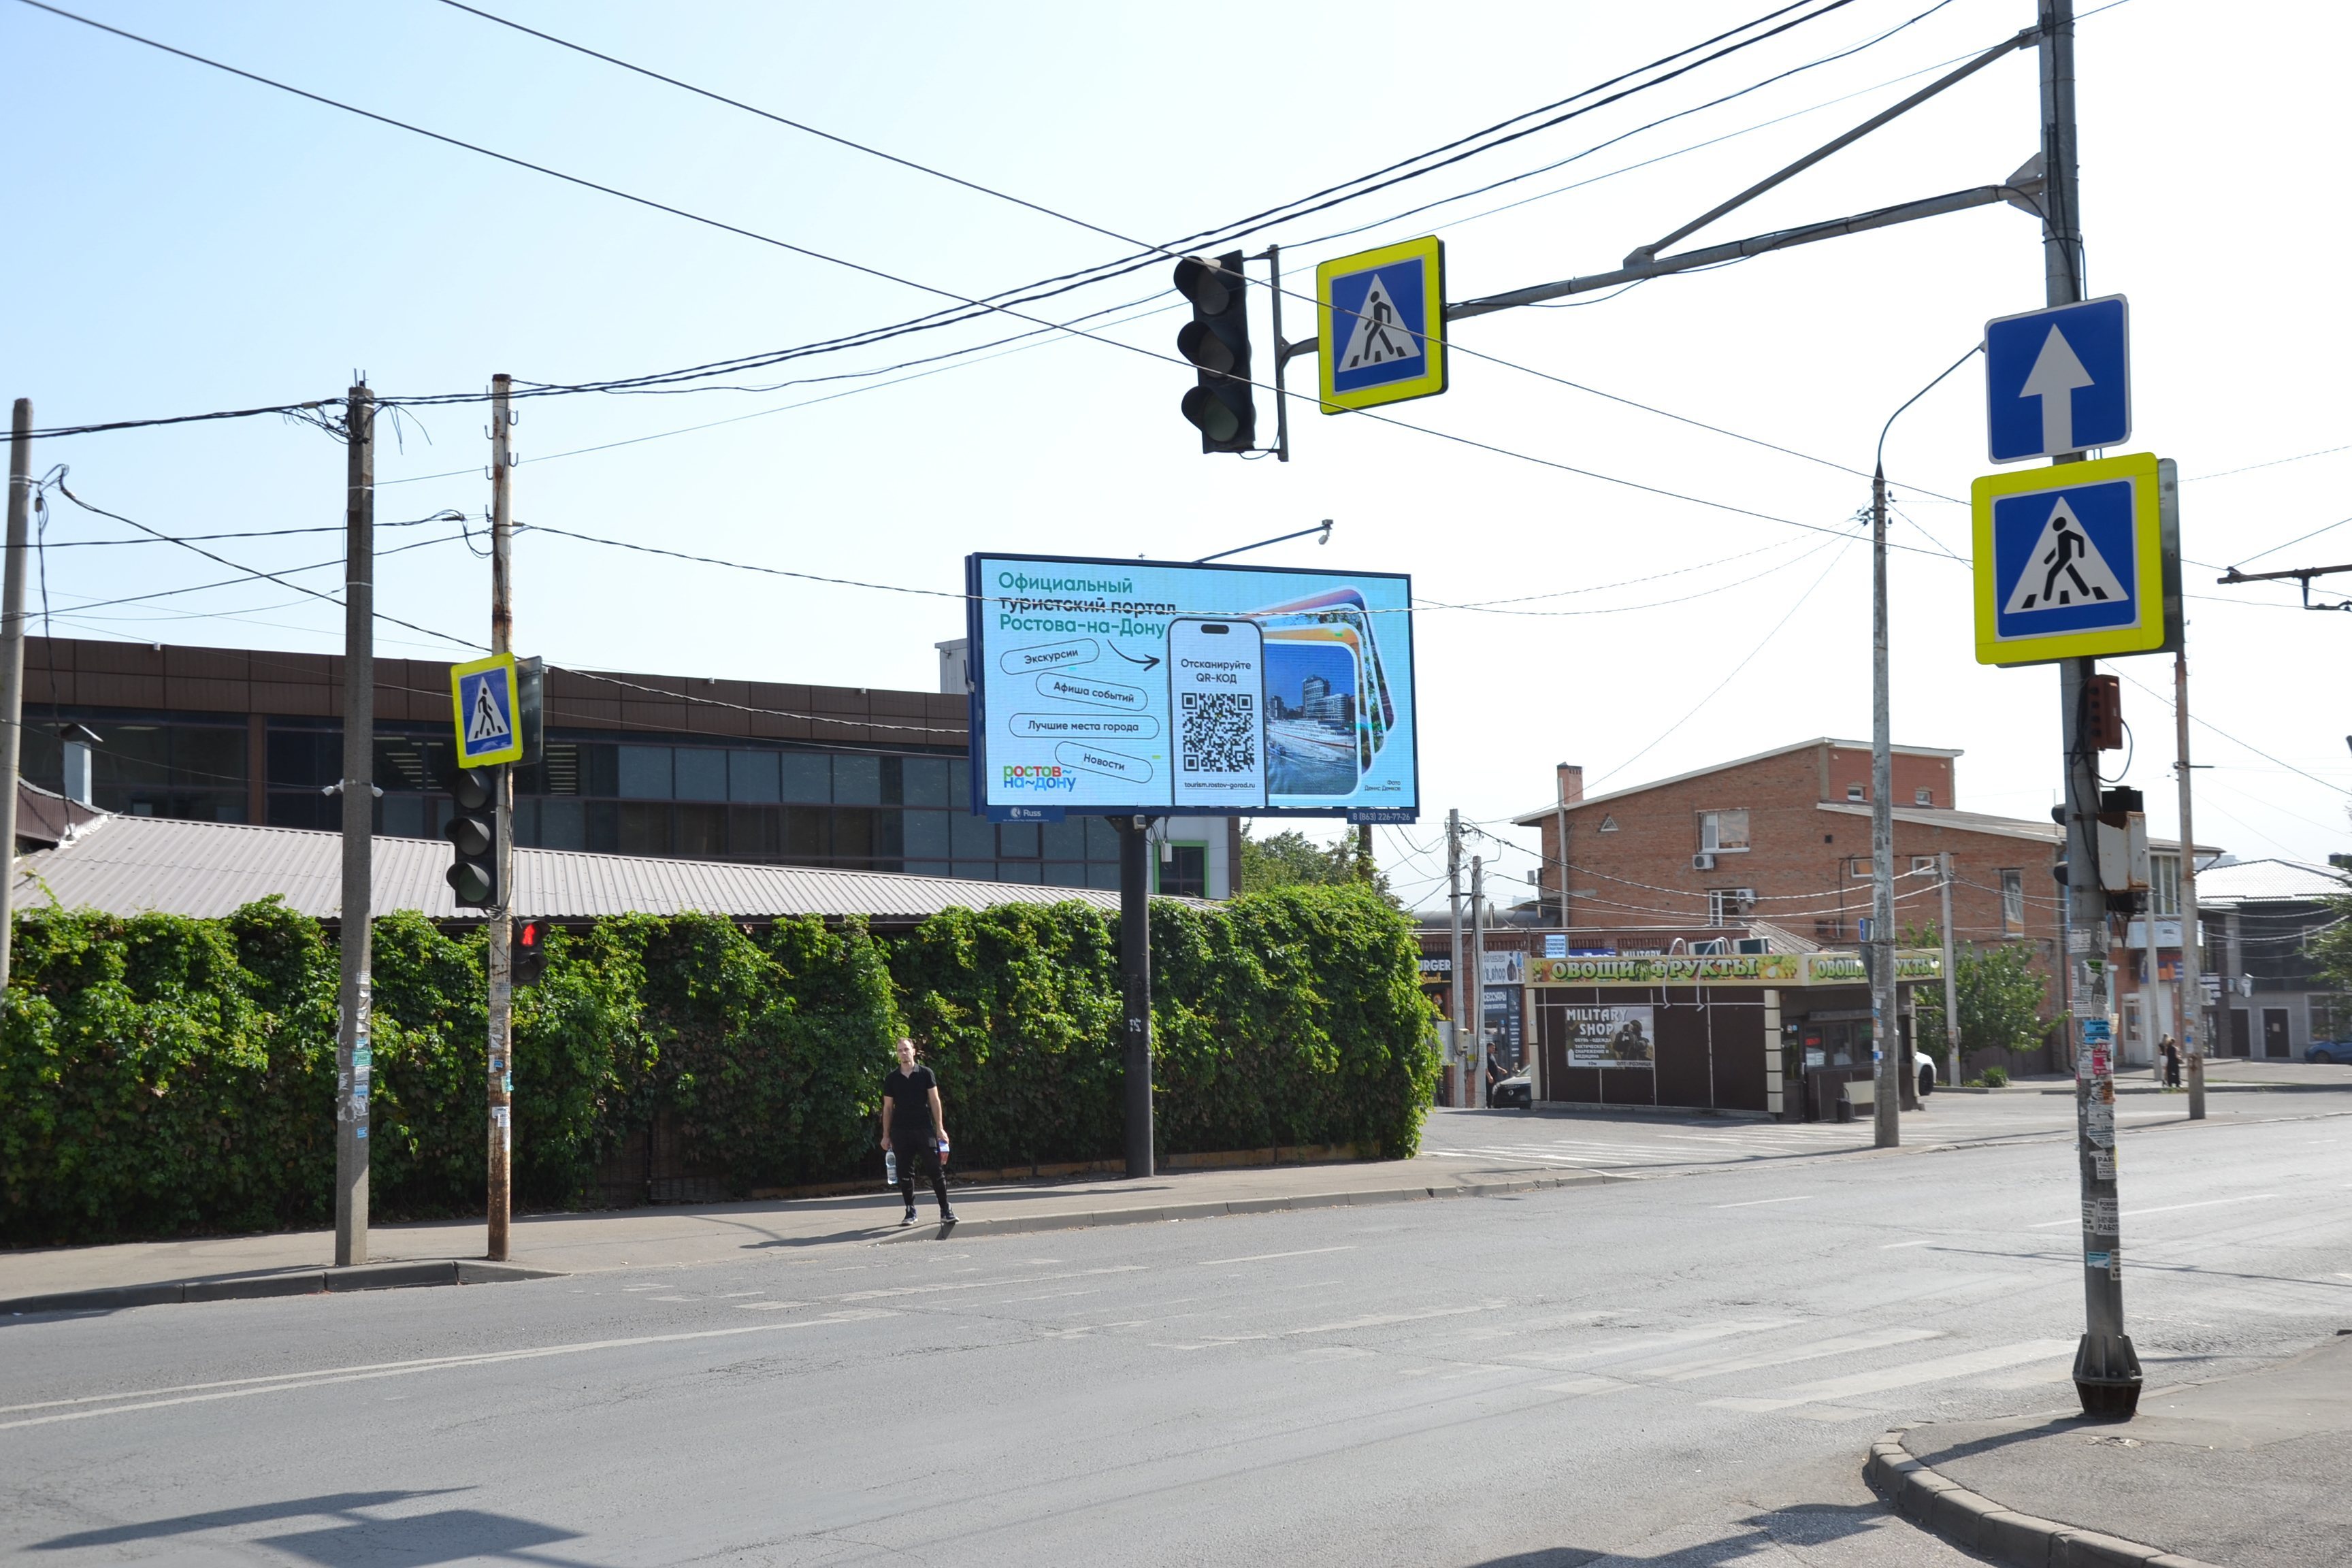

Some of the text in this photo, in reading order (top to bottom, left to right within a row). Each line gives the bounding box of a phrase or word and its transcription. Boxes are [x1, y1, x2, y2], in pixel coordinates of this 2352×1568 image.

[998, 572, 1133, 593] Официальный
[998, 597, 1177, 618] туристский портал
[1000, 614, 1166, 639] Ростова-на-Дону
[1024, 649, 1079, 664] Экскурсии
[1181, 658, 1252, 671] Отсканируйте
[1196, 672, 1237, 684] QR-КОД
[1054, 681, 1134, 703] Афиша событий
[1028, 720, 1139, 734] Лучшие места города
[1083, 753, 1125, 771] Новости
[1184, 781, 1256, 789] tourism.rostov-gorod.ru
[1352, 812, 1411, 821] 8 (863) 226-77-26
[1418, 959, 1452, 971] URGER
[1552, 958, 1758, 981] ОВОЩИ ФРУКТЫ
[1567, 1009, 1628, 1022] MILITARY
[1580, 1023, 1614, 1036] SHOP
